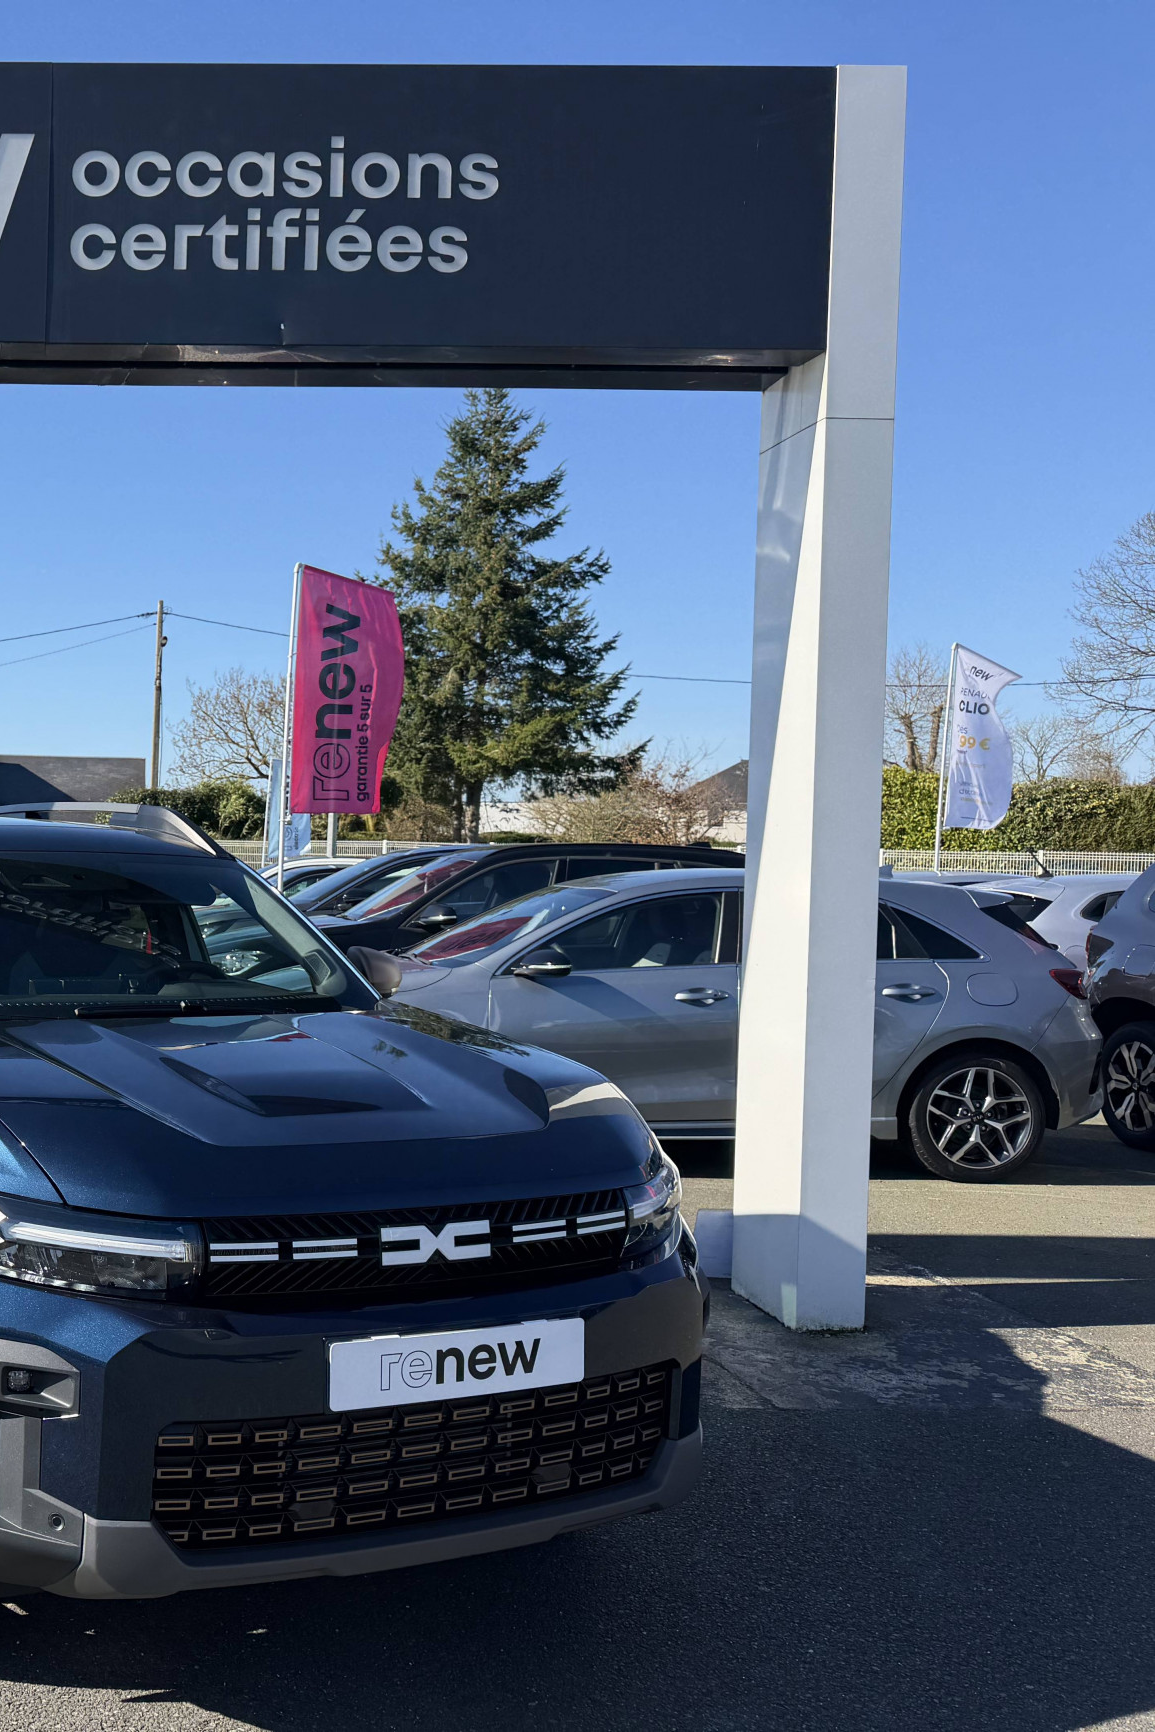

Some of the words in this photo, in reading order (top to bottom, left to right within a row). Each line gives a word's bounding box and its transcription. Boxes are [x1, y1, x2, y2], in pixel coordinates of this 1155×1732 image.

[72, 136, 499, 200] occasions
[70, 207, 468, 273] certifiées
[313, 603, 361, 802] renew
[359, 694, 372, 720] sur
[360, 684, 373, 693] 5
[958, 700, 991, 715] CLIO
[357, 720, 370, 733] 5
[355, 736, 370, 802] garantie
[380, 1338, 541, 1391] renew
